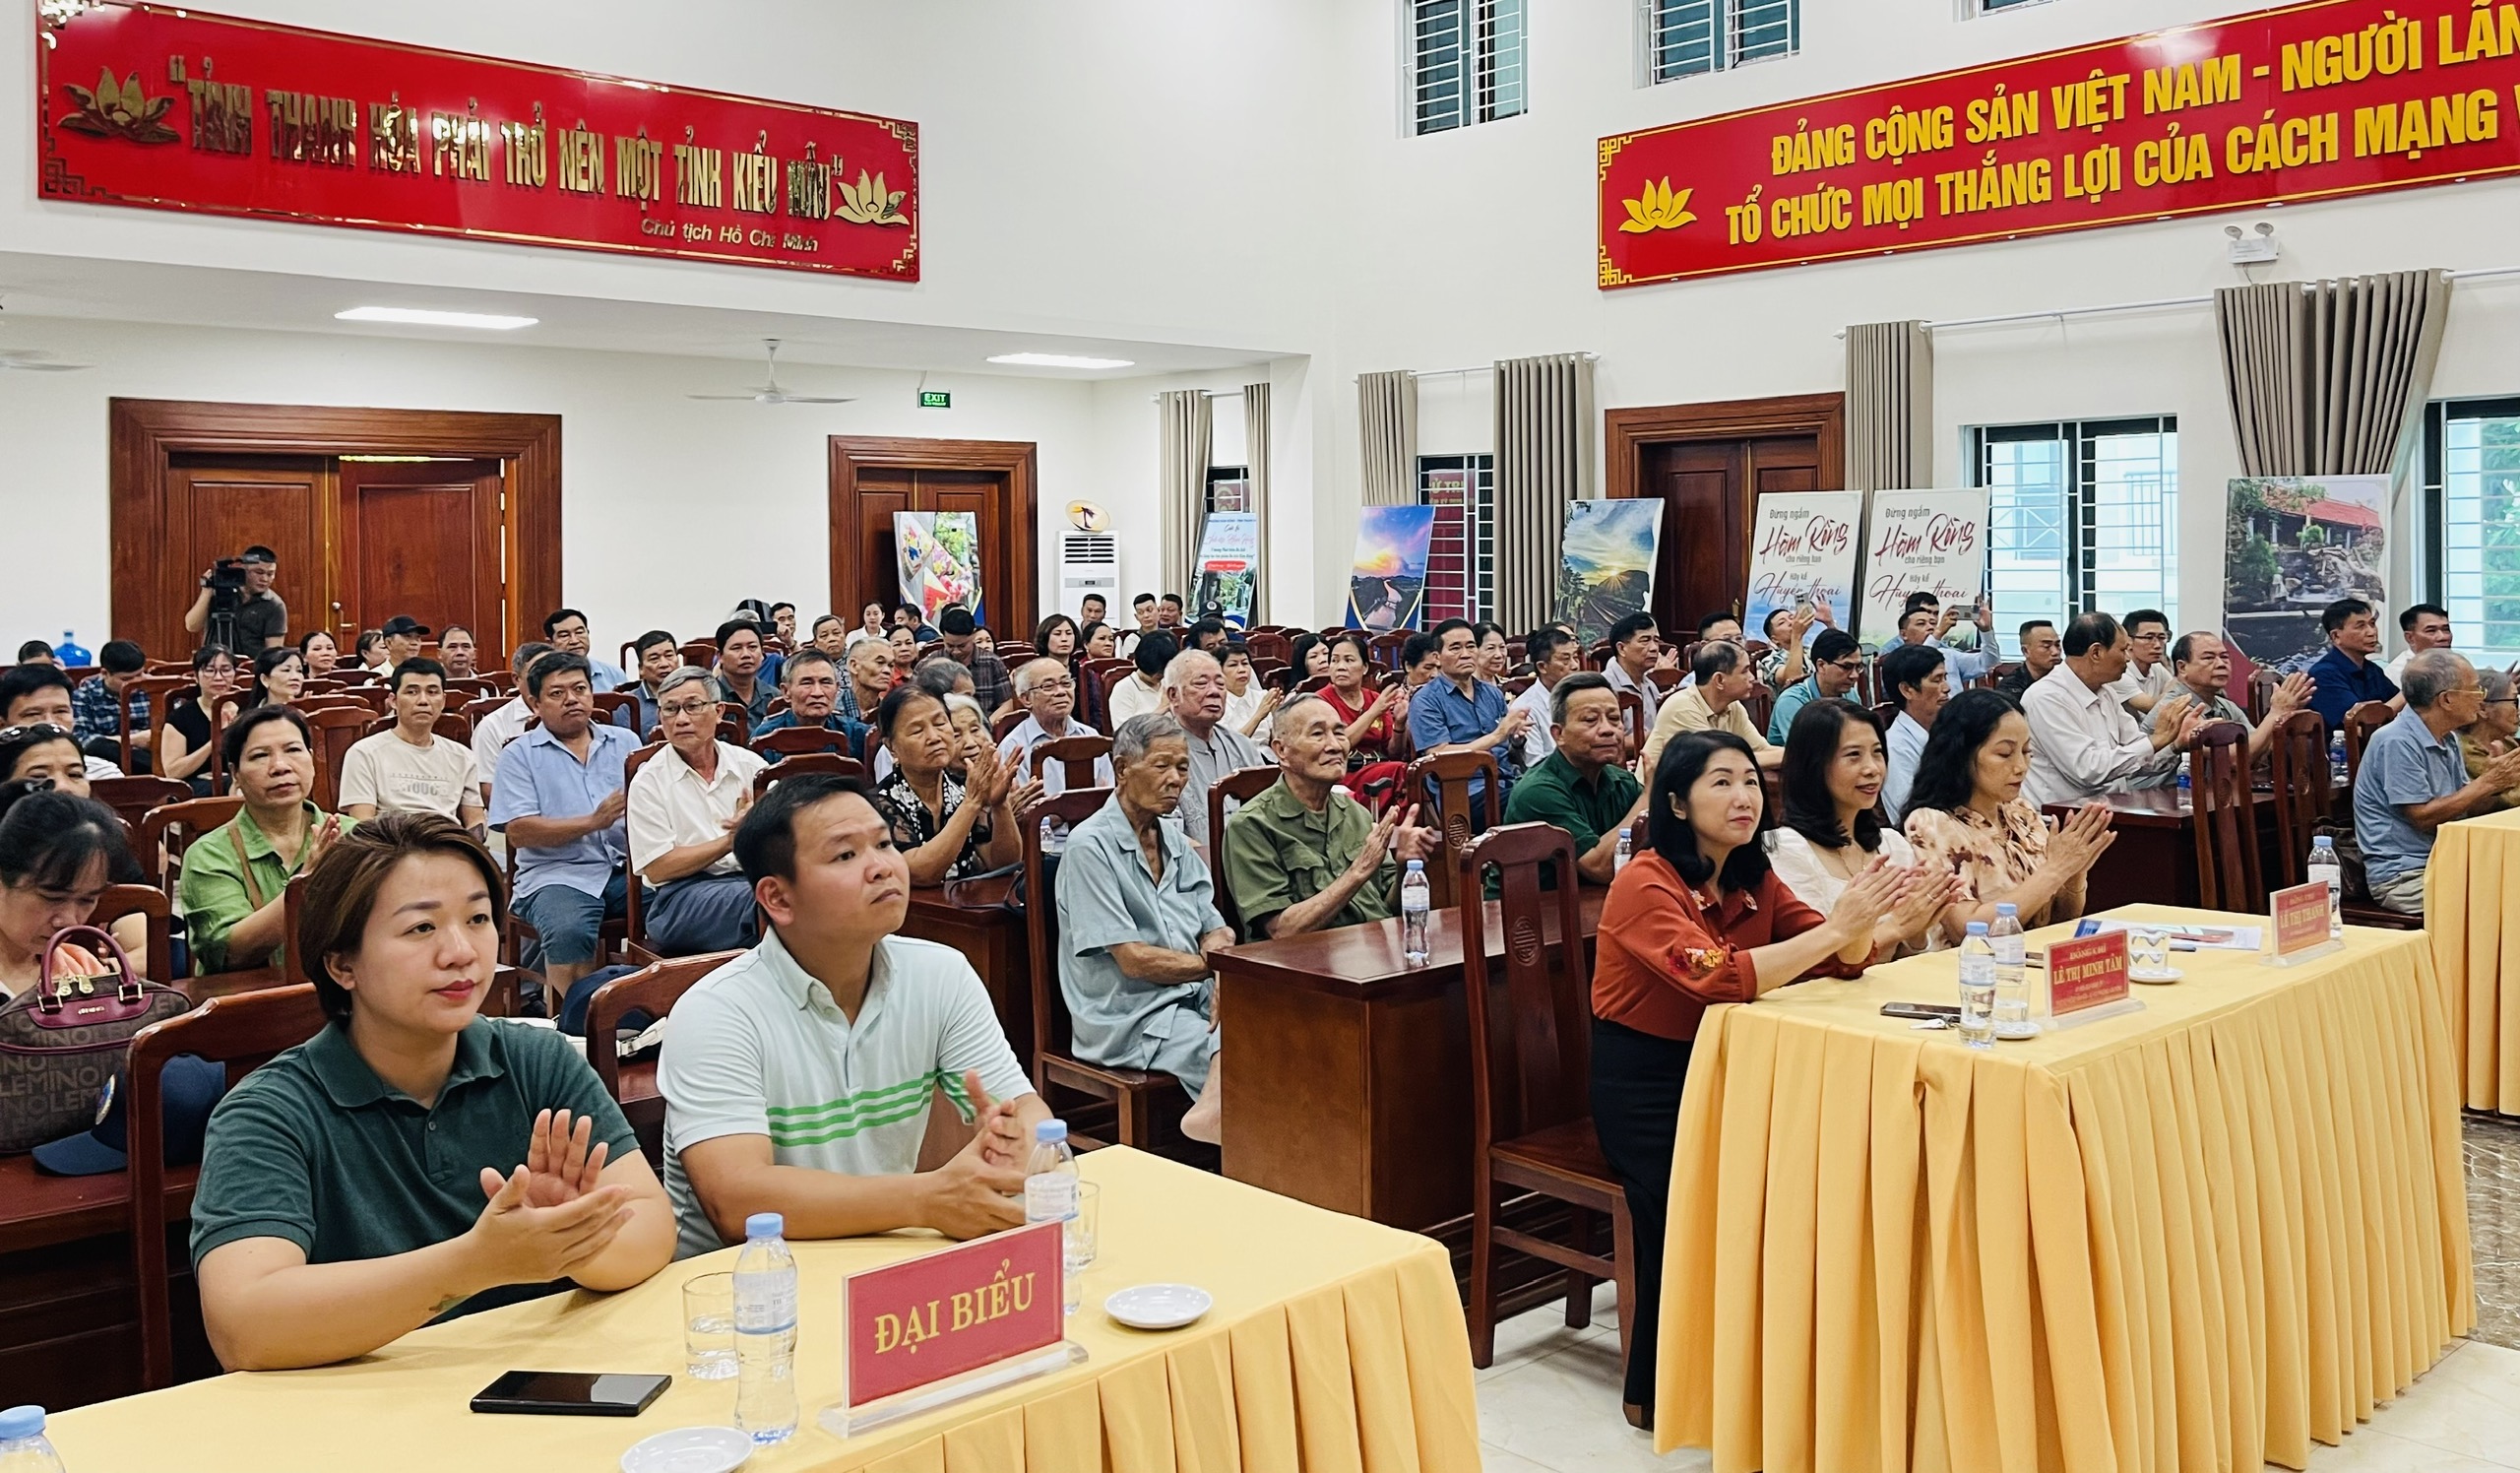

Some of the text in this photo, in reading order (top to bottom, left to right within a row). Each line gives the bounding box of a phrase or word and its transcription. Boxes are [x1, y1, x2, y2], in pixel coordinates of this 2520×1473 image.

[1772, 116, 1855, 175] ĐẢNG
[1865, 104, 1954, 165] CỘNG
[1966, 84, 2039, 143] SẢN
[2051, 69, 2130, 133] VIỆT
[2143, 54, 2241, 115] NAM
[2282, 11, 2423, 92] NGƯỜI
[266, 90, 356, 166] THANH
[431, 96, 490, 181] PHẢI
[558, 118, 604, 193] NÊN
[615, 126, 662, 211] MỘT
[673, 125, 722, 208] TỈNH
[732, 130, 778, 214] KIỂU
[1725, 184, 1763, 245] TỔ
[1771, 182, 1853, 239] CHỨC
[1862, 176, 1924, 230] MỌI
[1935, 150, 2051, 216] THẮNG
[2064, 143, 2121, 204] LỢI
[2133, 122, 2214, 188] CỦA
[2226, 109, 2339, 175] CÁCH
[2354, 89, 2498, 160] MẠNG
[682, 223, 712, 242] tịch
[720, 224, 742, 243] Hồ
[784, 233, 818, 252] Minh
[924, 393, 946, 403] EXIT
[1770, 509, 1788, 520] Đừng
[1885, 506, 1929, 520] Đừng ngắm
[1759, 514, 1849, 564] Hàm Rồng
[1874, 513, 1976, 566] Hàm Rồng
[1917, 554, 1932, 564] riêng
[2053, 965, 2065, 985] LÊ
[2065, 966, 2081, 983] THỊ
[2082, 961, 2105, 979] MINH
[874, 1258, 1037, 1355] ĐẠI BIỂU
